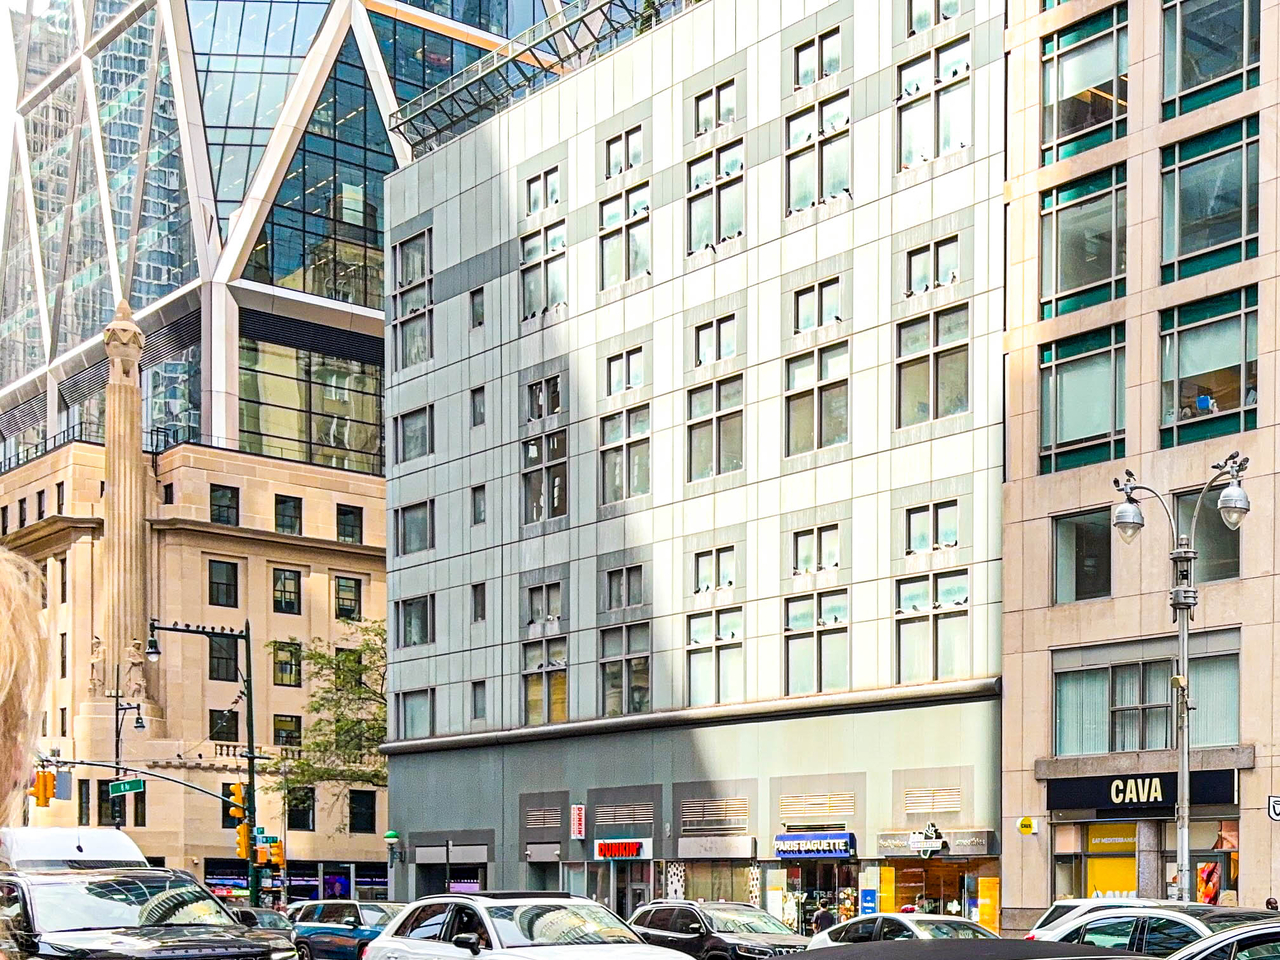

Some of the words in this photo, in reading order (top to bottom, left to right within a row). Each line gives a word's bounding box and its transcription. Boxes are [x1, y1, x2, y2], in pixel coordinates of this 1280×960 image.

[1111, 778, 1163, 804] CAVA
[774, 840, 799, 851] PARIS
[800, 839, 846, 851] BAGUETTE
